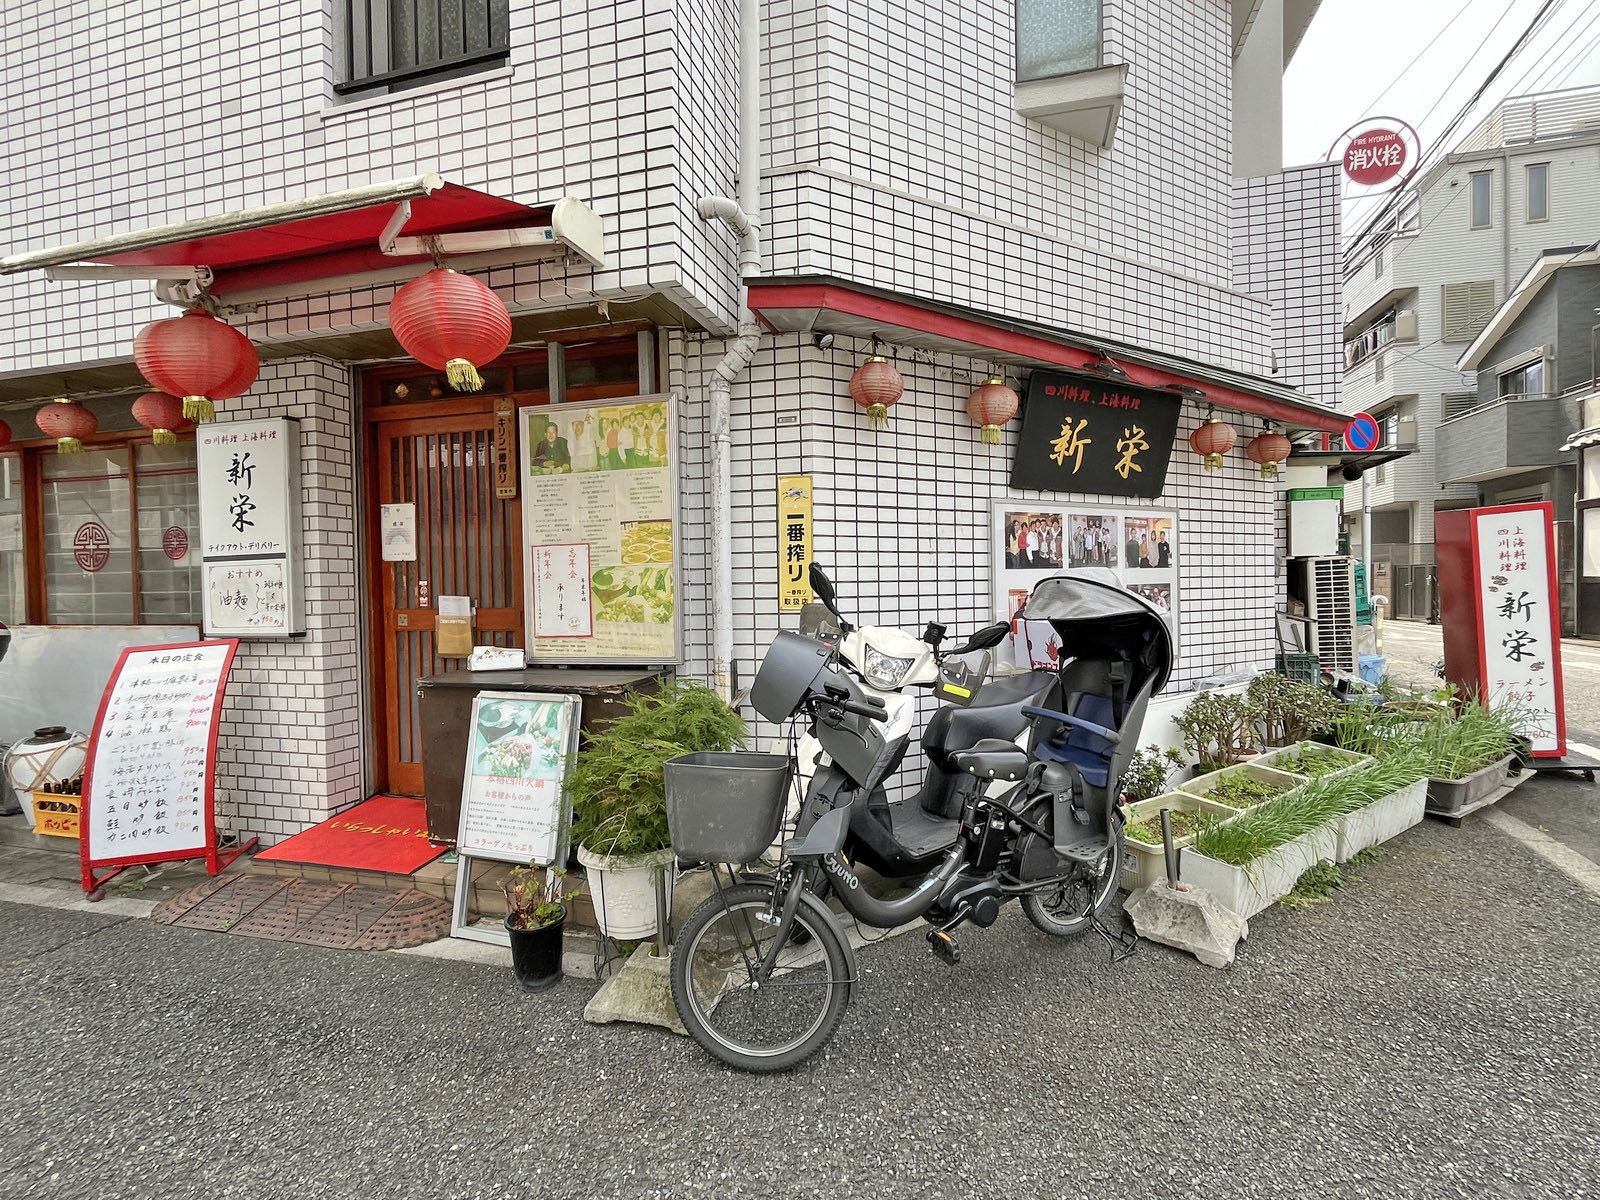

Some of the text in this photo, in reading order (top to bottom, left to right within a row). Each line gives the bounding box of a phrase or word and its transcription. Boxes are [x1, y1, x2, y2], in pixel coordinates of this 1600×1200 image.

[1368, 133, 1397, 143] HYDRANT
[1348, 143, 1402, 171] 消火栓
[786, 513, 806, 583] 一番搾り
[1497, 529, 1512, 572] 四川料理
[1513, 526, 1527, 571] 上海料理
[543, 549, 553, 580] 新年会
[567, 547, 578, 579] 忘年会
[227, 568, 264, 580] おすすめ
[556, 582, 565, 621] 承ります
[783, 597, 809, 606] 取扱店
[1496, 591, 1539, 663] 新栄
[149, 653, 204, 665] 本日の定食
[1496, 678, 1549, 689] ラーメン
[1507, 690, 1536, 702] 餃子
[105, 729, 114, 738] 4
[44, 818, 78, 831] ホッピー
[474, 839, 534, 853] コラーゲンたっぷり
